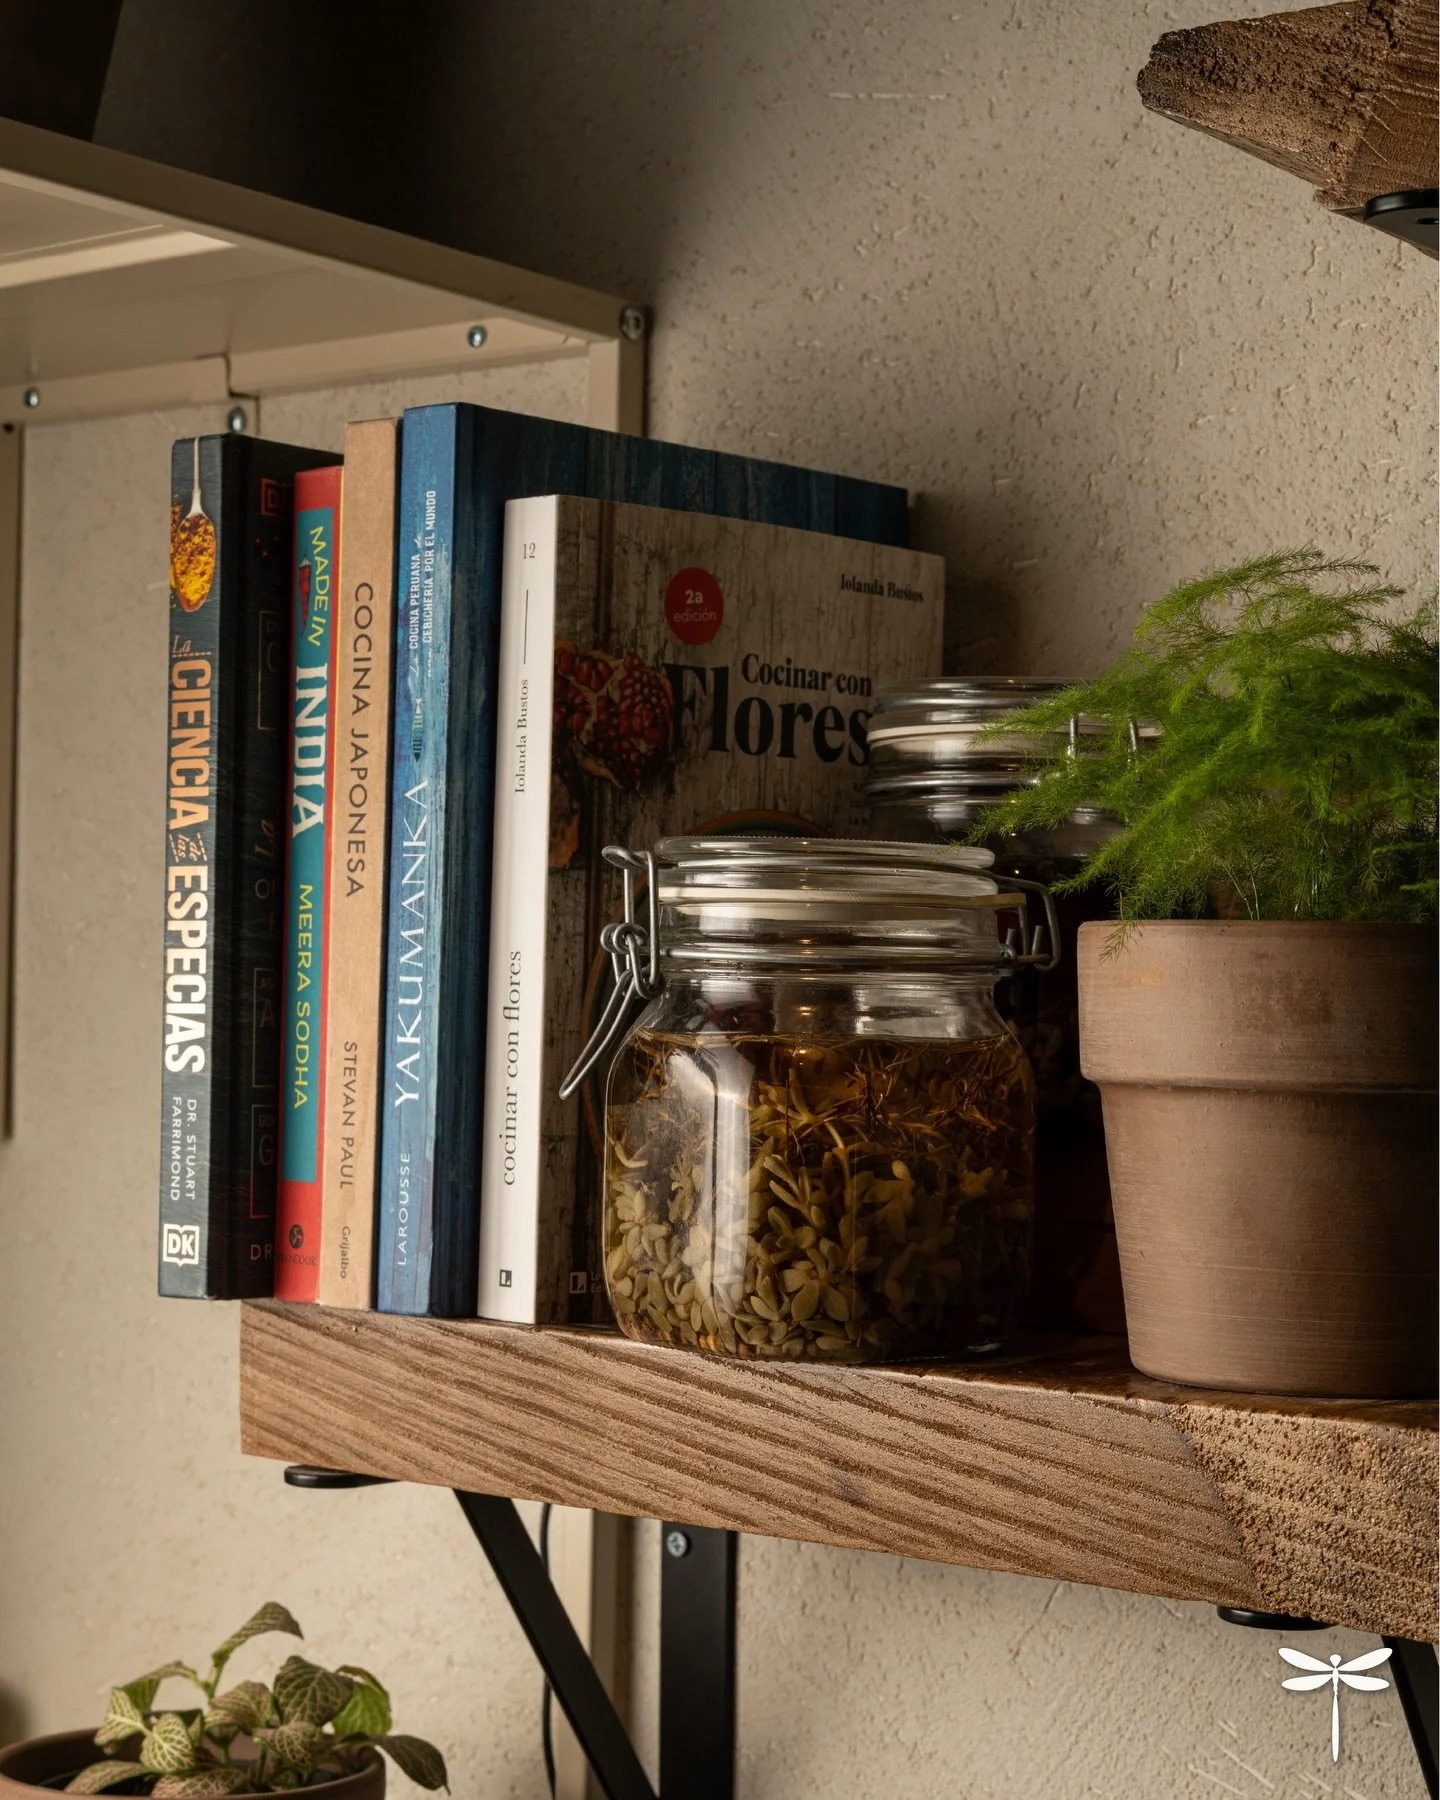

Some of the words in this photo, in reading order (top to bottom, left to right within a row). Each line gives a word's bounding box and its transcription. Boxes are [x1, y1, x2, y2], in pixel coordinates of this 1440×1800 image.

[425, 533, 435, 548] EL
[426, 490, 436, 531] MUNDO
[311, 526, 330, 611] MADE
[424, 550, 434, 572] POR
[523, 542, 536, 560] 12
[410, 554, 421, 609] PERUANA
[422, 578, 433, 643] CEBICHERÍA
[684, 589, 704, 605] 2a
[840, 573, 884, 596] Iolanda
[887, 581, 924, 602] Bustos
[308, 615, 326, 646] IN
[409, 610, 419, 650] COCINA
[673, 606, 717, 624] edición
[352, 582, 373, 716] COCINA
[742, 653, 833, 691] Cocinar
[836, 674, 872, 697] con
[516, 679, 529, 729] Bustos
[663, 662, 873, 767] Flores
[169, 659, 212, 830] CIENCIA
[292, 661, 328, 839] INDIA
[514, 734, 527, 794] Iolanda
[346, 728, 370, 898] JAPONESA
[296, 884, 313, 992] MEERA
[395, 780, 429, 1108] YAKUMANKA
[164, 865, 208, 1073] ESPECIAS
[503, 951, 521, 1021] flores
[293, 1001, 312, 1109] SODHA
[342, 1041, 357, 1127] STEVAN
[508, 1030, 519, 1079] con
[187, 1099, 197, 1127] DR.
[499, 1087, 518, 1186] cocinar
[170, 1096, 182, 1201] FARRIMOND
[185, 1135, 196, 1200] STUART
[340, 1137, 355, 1189] PAUL
[398, 1152, 411, 1266] LAROUSSE
[168, 1233, 194, 1256] DK
[340, 1225, 350, 1280] Grijalbo
